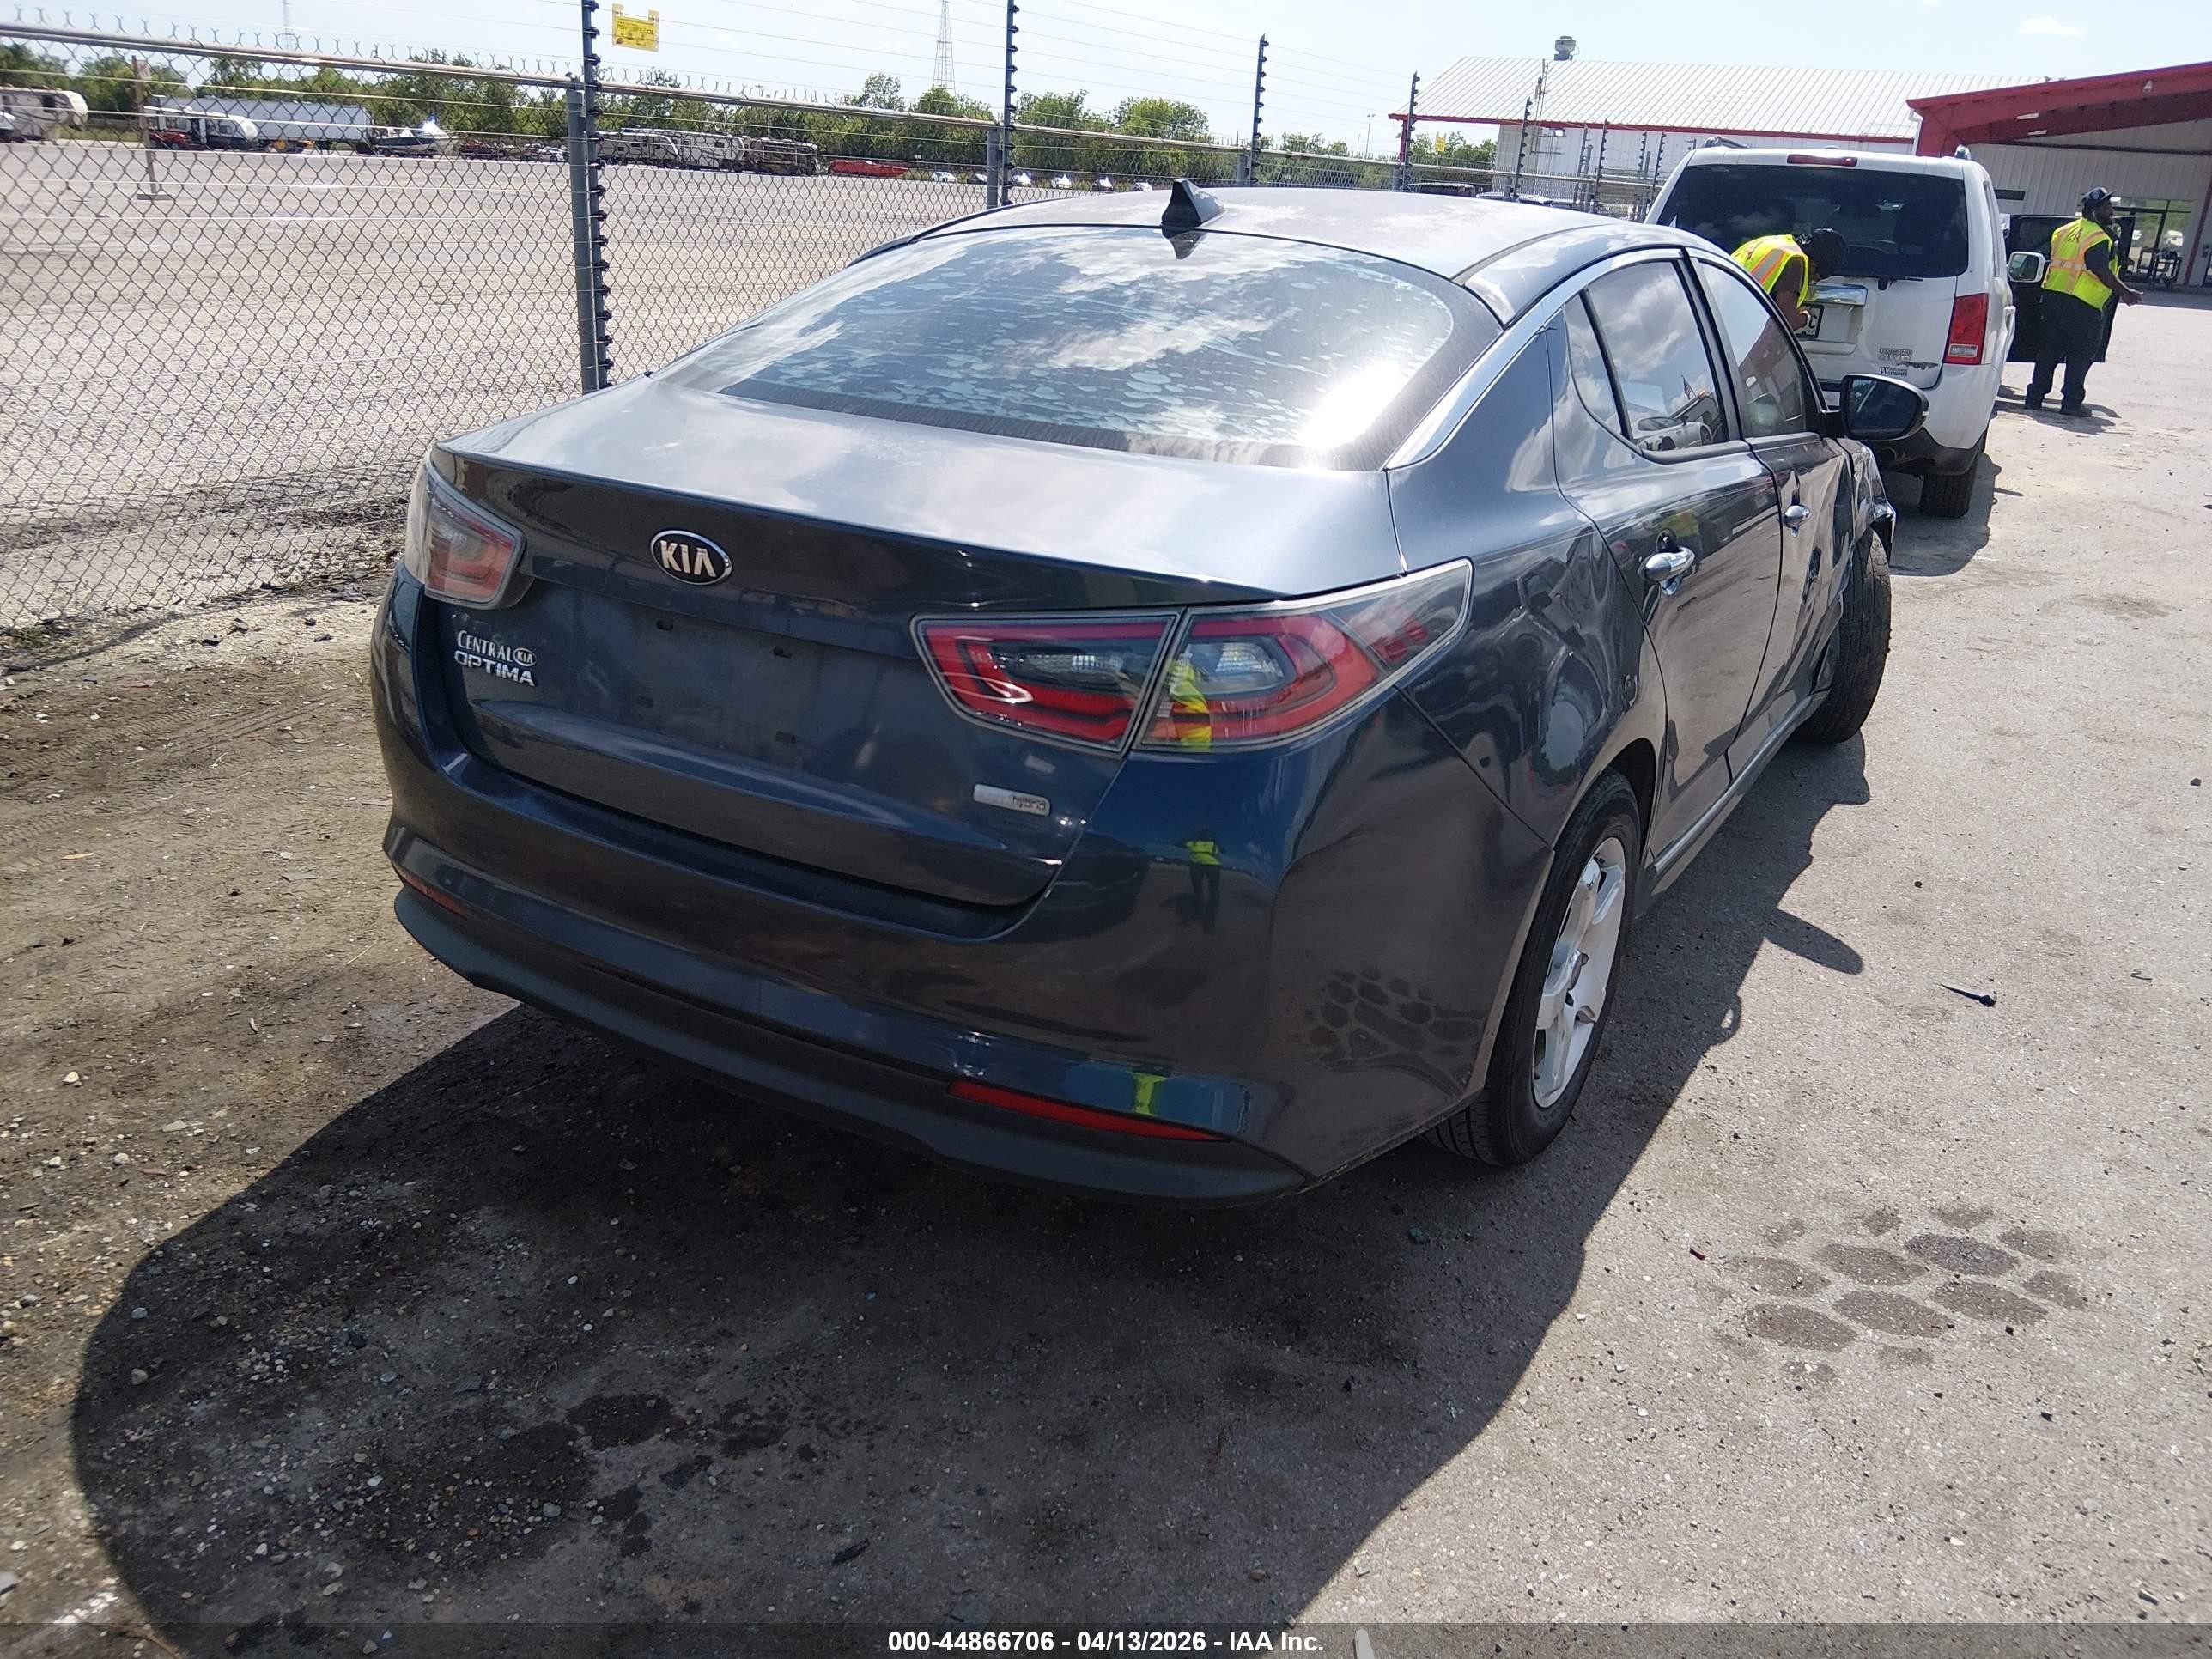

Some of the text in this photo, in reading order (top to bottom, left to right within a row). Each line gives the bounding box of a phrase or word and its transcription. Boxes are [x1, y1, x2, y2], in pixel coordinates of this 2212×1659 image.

[659, 539, 717, 577] KIA
[457, 630, 533, 664] CENTRAL KIA
[454, 650, 535, 687] OPTIMA
